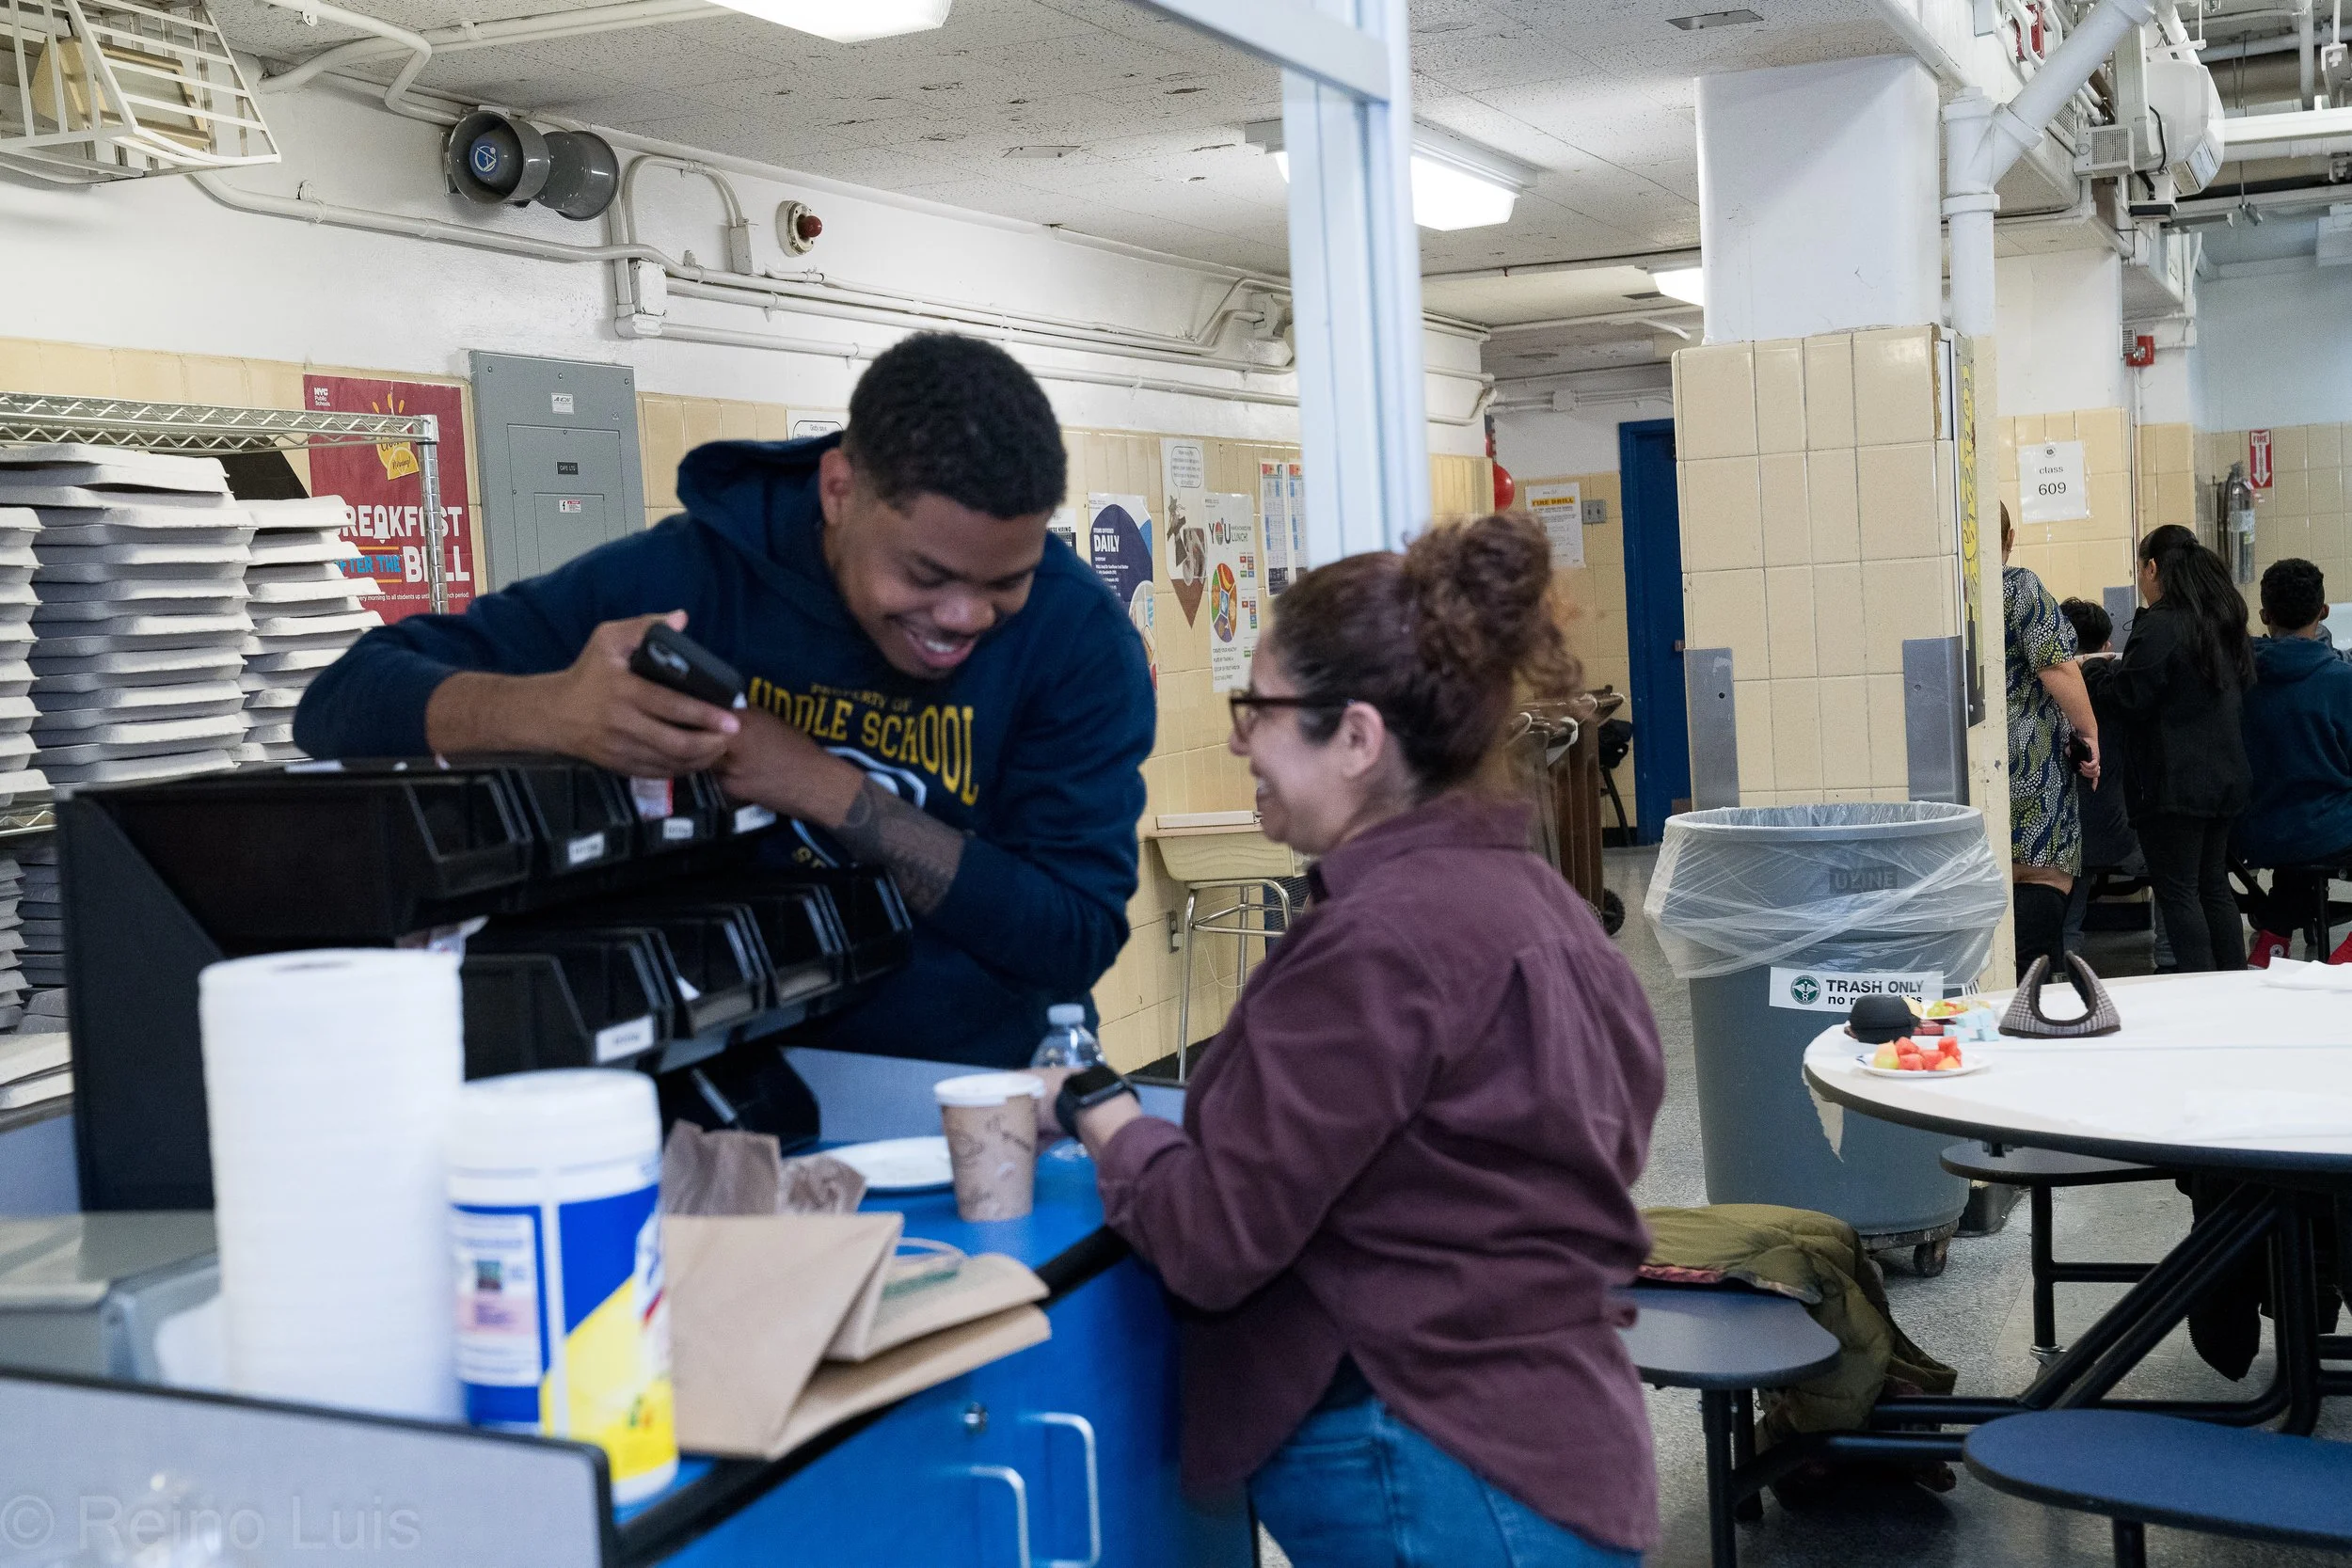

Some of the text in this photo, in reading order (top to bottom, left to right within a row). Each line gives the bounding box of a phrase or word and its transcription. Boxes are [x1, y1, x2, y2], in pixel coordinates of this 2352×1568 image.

[2039, 482, 2067, 496] 609
[1093, 534, 1120, 552] DAILY
[376, 554, 402, 573] THE
[403, 546, 470, 583] BL
[749, 676, 979, 806] IDDLE SCHOOL
[1826, 979, 1883, 993] TRASH
[1887, 980, 1924, 993] ONLY
[1828, 995, 1845, 1006] no
